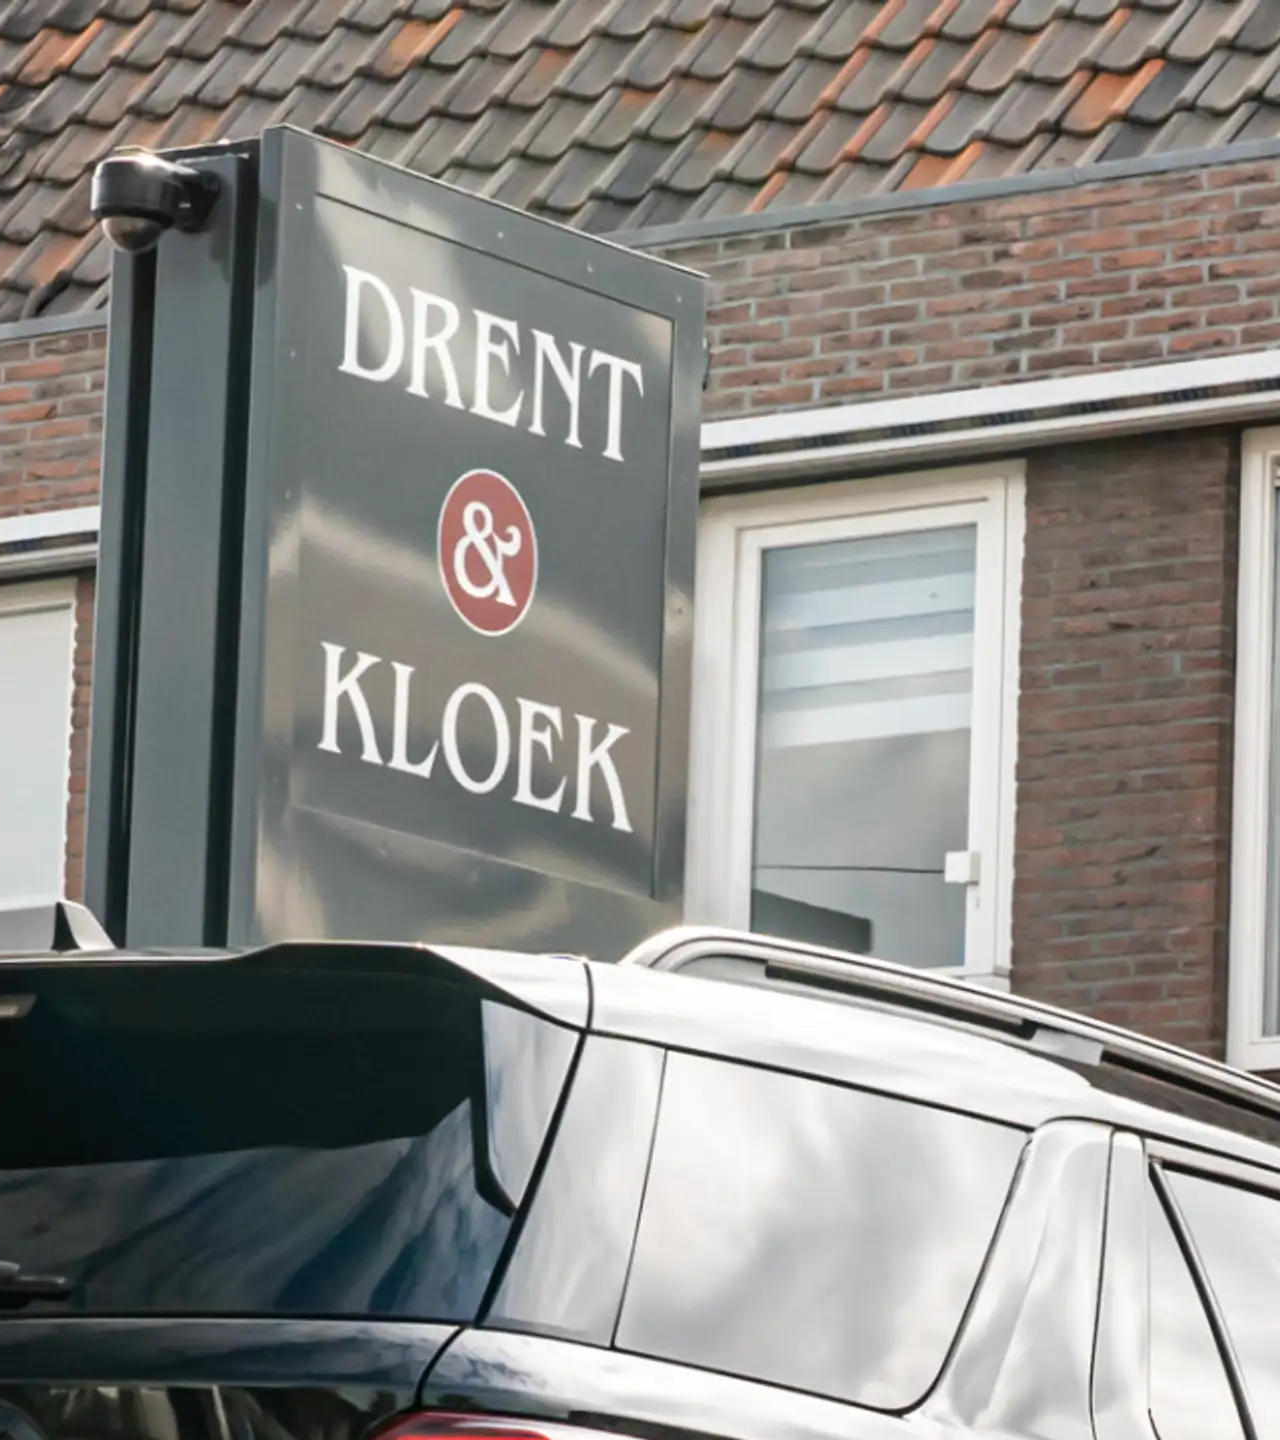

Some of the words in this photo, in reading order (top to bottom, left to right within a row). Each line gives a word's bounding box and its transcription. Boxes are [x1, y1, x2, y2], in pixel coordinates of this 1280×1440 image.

[338, 264, 644, 462] DRENT
[453, 500, 521, 608] &
[317, 641, 632, 832] KLOEK
